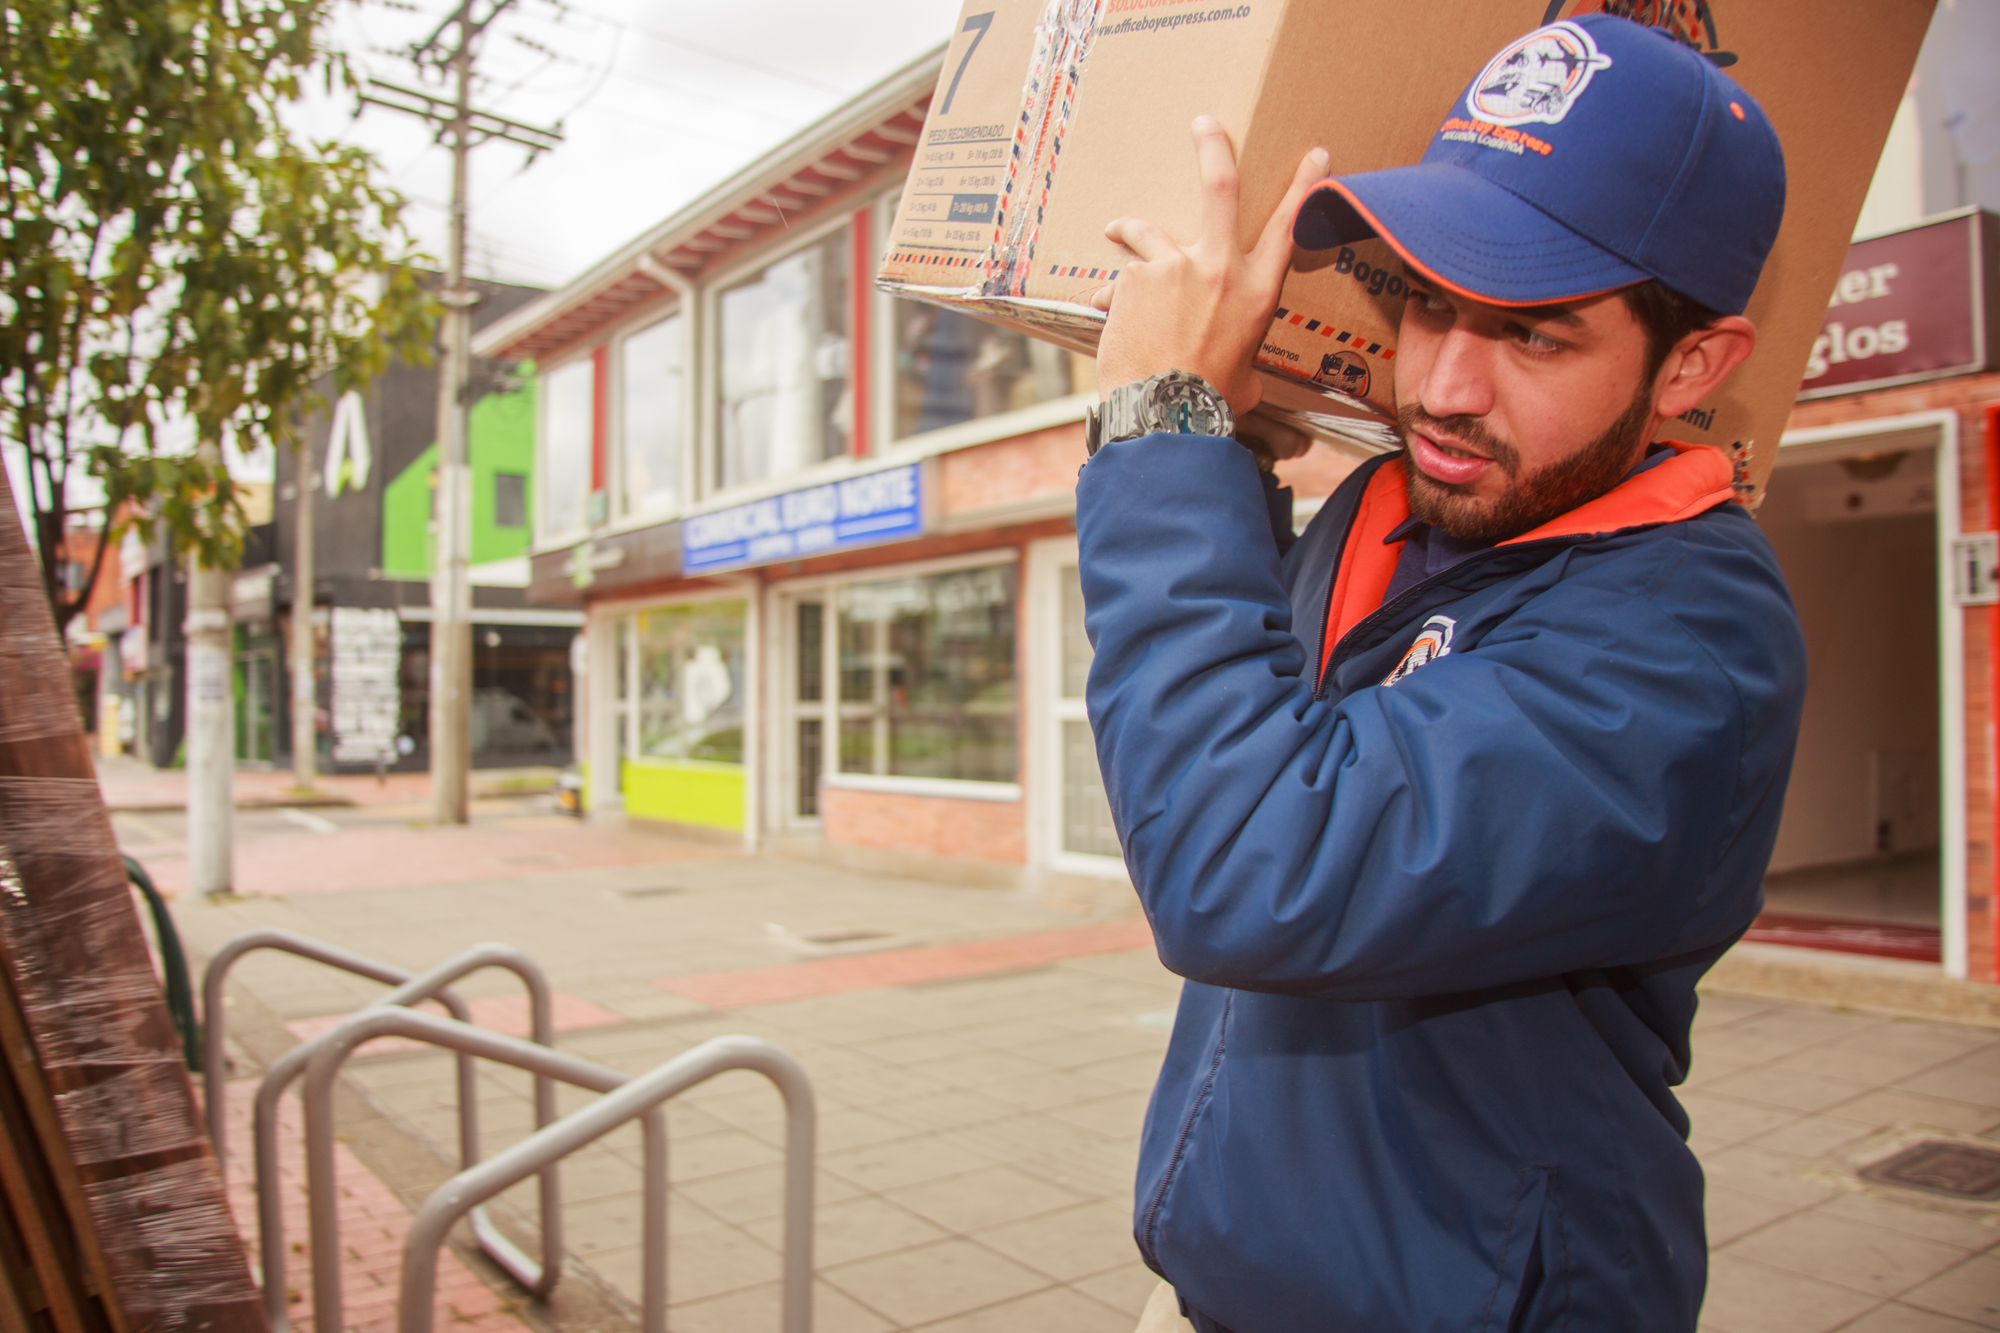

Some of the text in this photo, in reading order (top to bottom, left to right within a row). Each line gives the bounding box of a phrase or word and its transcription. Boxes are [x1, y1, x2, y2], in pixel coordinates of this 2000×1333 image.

[939, 11, 996, 116] 7
[929, 124, 1004, 142] PESO RECOMENDADO
[1828, 262, 1899, 308] er
[1262, 342, 1300, 363] SOLUCIÓN
[839, 465, 917, 519] NORTE
